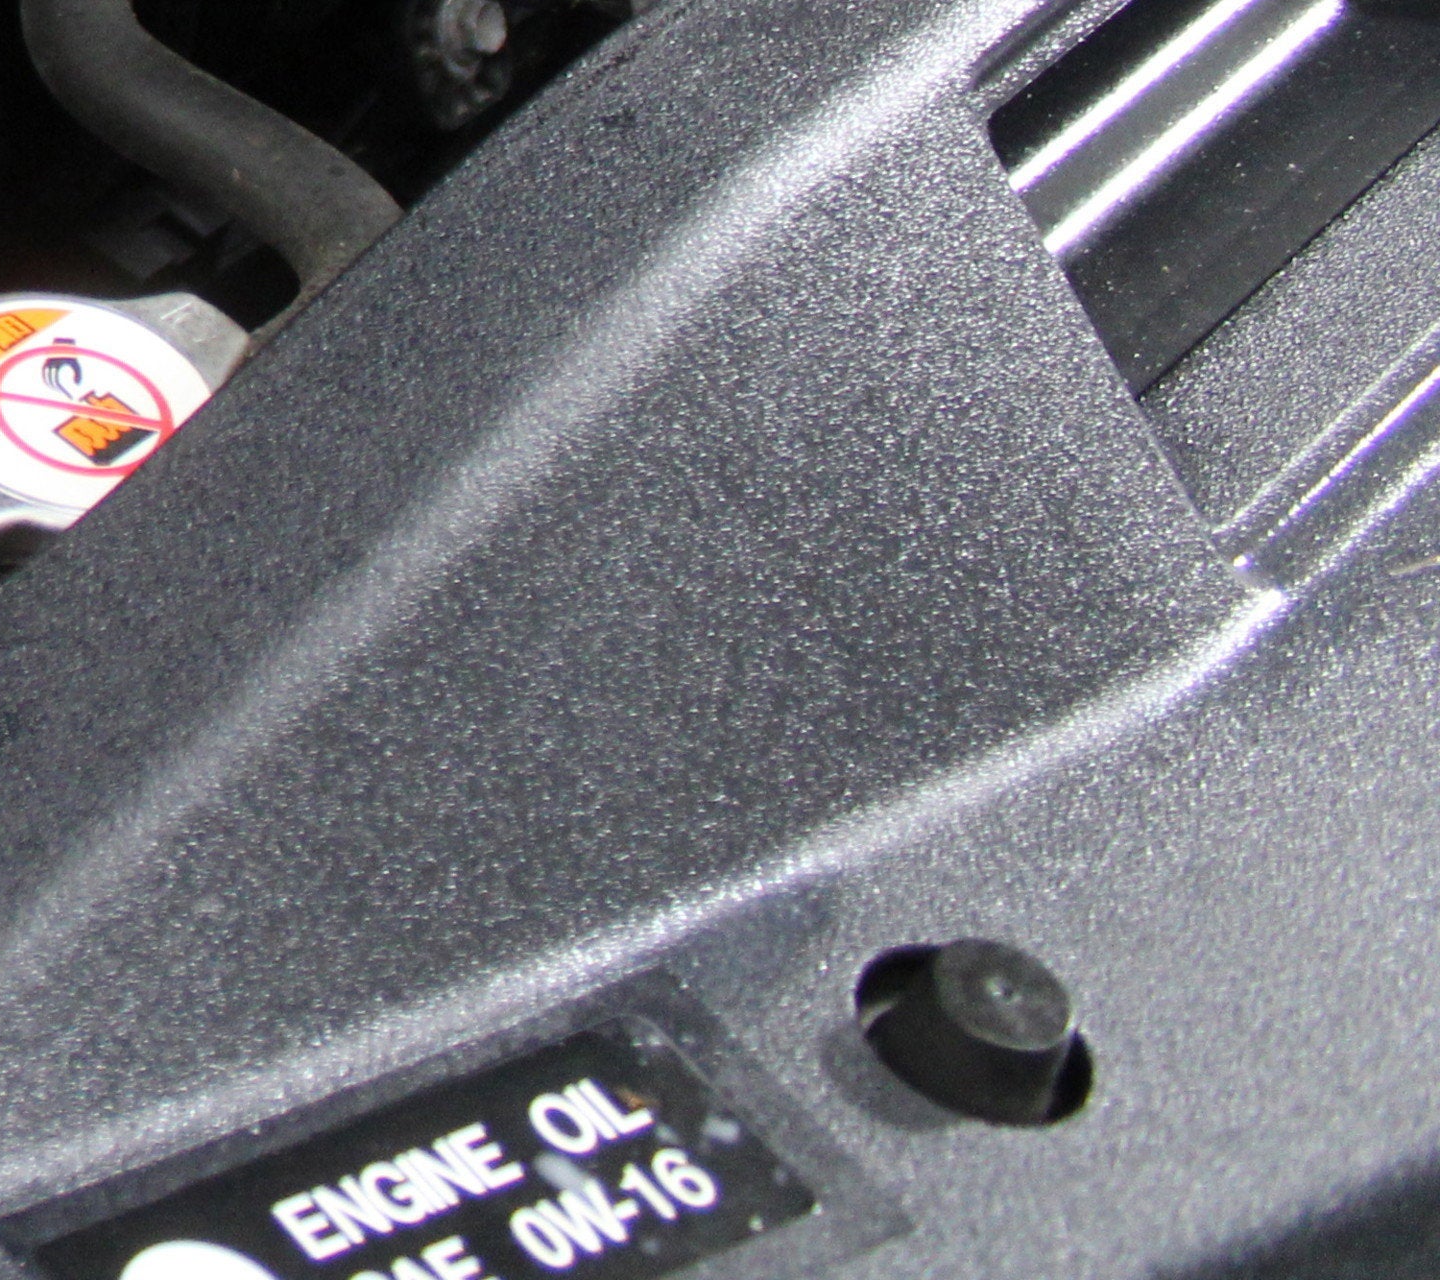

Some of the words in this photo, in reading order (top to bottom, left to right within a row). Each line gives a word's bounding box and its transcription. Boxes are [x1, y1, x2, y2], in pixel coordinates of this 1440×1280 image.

[270, 1120, 526, 1262] ENGINE
[528, 1076, 654, 1155] OIL
[508, 1146, 718, 1269] 0W-16
